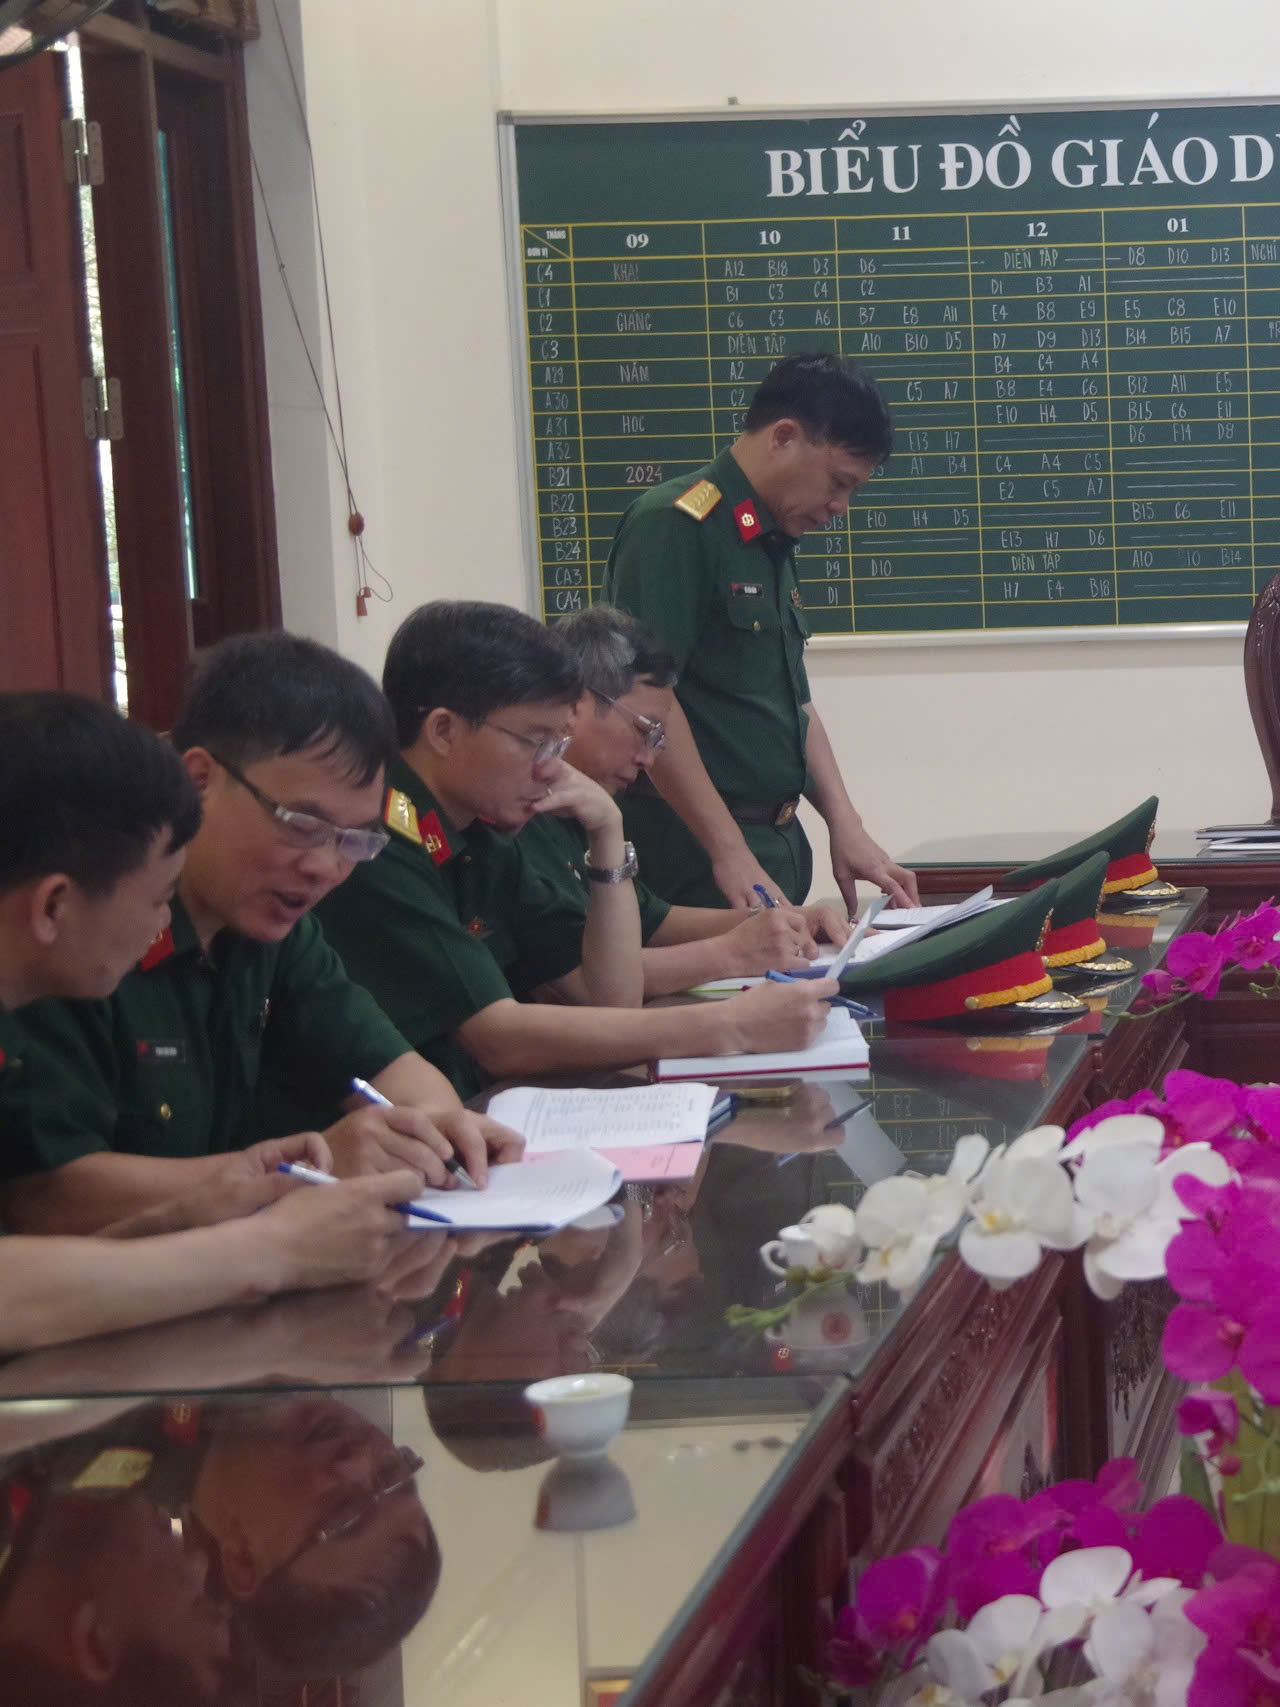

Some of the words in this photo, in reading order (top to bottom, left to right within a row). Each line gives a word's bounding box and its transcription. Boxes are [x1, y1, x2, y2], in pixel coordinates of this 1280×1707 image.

[765, 119, 921, 197] BIỂU
[939, 116, 1032, 191] ĐỒ
[1052, 113, 1218, 187] GIÁO
[626, 233, 649, 248] 09
[759, 230, 781, 245] 10
[892, 226, 911, 240] 11
[1026, 223, 1048, 237] 12
[1167, 218, 1188, 232] 01
[1128, 247, 1145, 265] D8
[1168, 247, 1188, 264] D10
[1211, 245, 1230, 262] D13
[537, 264, 553, 282] C4
[724, 260, 744, 277] A12
[814, 258, 829, 275] D3
[860, 258, 876, 274] D6
[726, 286, 739, 301] B1
[769, 284, 785, 300] C3
[814, 282, 828, 298] C4
[861, 280, 875, 296] C2
[992, 277, 1002, 293] D1
[1036, 276, 1053, 293] B3
[1079, 275, 1091, 292] A1
[539, 289, 551, 307] C1
[1168, 299, 1185, 316] C8
[769, 311, 785, 327] C3
[815, 309, 831, 325] A6
[859, 307, 875, 323] B7
[1037, 302, 1055, 319] B8
[540, 314, 552, 332] C2
[862, 334, 881, 352] A10
[905, 333, 928, 351] B10
[946, 331, 962, 349] D5
[994, 331, 1006, 349] D7
[1038, 330, 1056, 347] D9
[1082, 328, 1101, 346] D13
[1126, 327, 1147, 344] B14
[1170, 325, 1191, 343] B15
[1214, 325, 1231, 342] A7
[542, 340, 558, 358] C3
[730, 362, 744, 379] A2
[995, 355, 1012, 372] B4
[1038, 354, 1053, 371] C4
[1082, 352, 1099, 369] A4
[907, 380, 923, 400] C5
[944, 381, 958, 399] A7
[997, 380, 1016, 397] B8
[1082, 376, 1097, 394] C6
[1128, 375, 1147, 393] B12
[730, 389, 745, 406] C2
[1040, 404, 1057, 422] H4
[1083, 402, 1098, 420] D5
[1128, 401, 1152, 420] B15
[1171, 401, 1187, 418] C6
[549, 467, 569, 487] B21
[626, 466, 662, 483] 2024
[1044, 481, 1060, 497] C5
[1087, 477, 1103, 495] A7
[553, 517, 576, 537] B23
[556, 541, 580, 560] B24
[556, 566, 581, 585] CA3
[826, 560, 840, 577] D9
[1004, 581, 1019, 598] H7
[1090, 578, 1110, 595] B18
[557, 591, 580, 609] CA4
